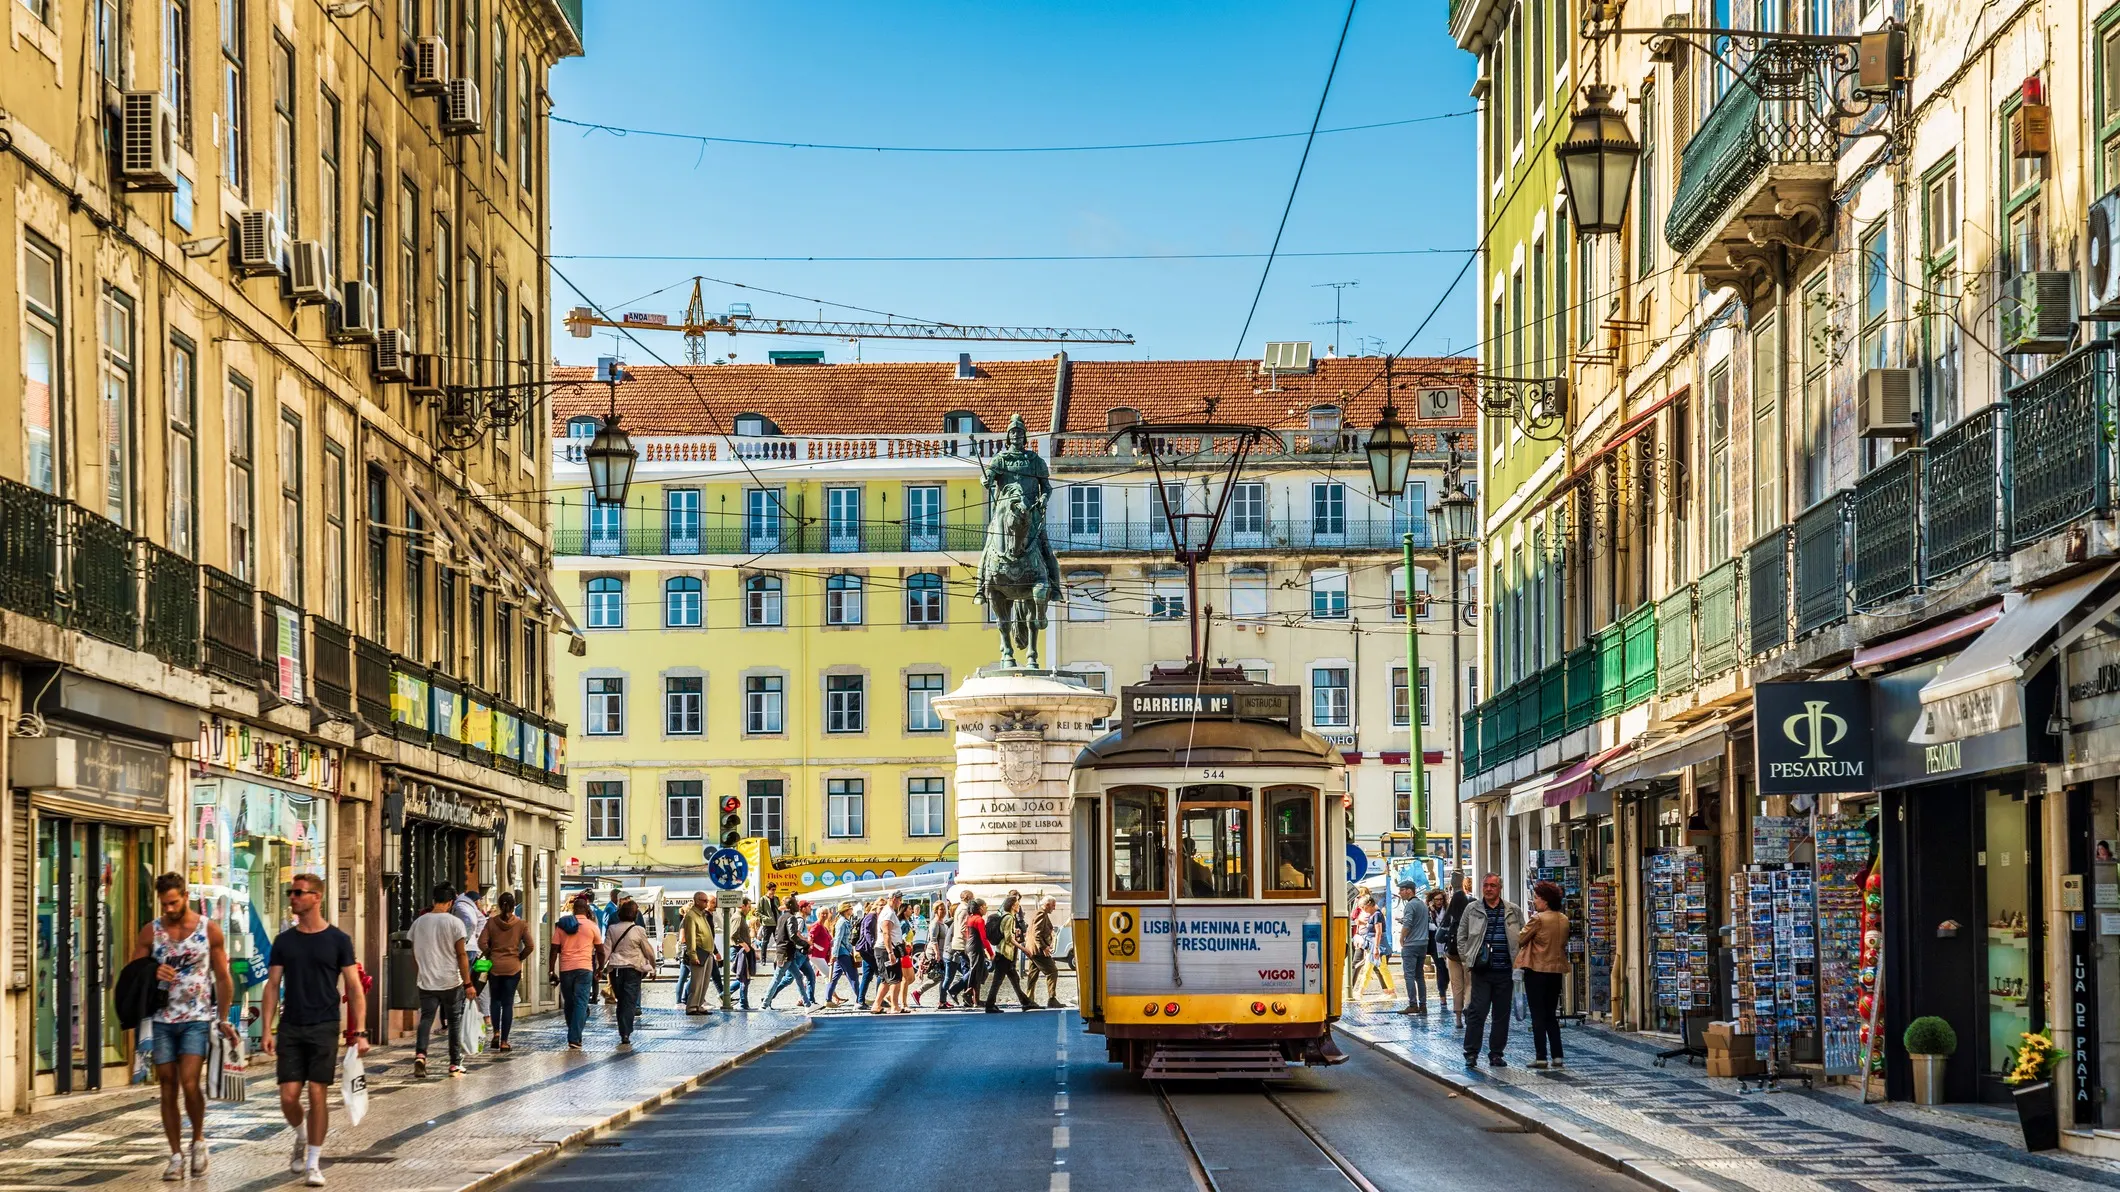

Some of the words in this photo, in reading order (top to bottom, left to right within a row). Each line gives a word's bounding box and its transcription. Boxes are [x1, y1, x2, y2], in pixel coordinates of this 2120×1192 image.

[1428, 391, 1448, 409] 10
[1133, 697, 1203, 712] CARREIRA
[1210, 697, 1228, 712] Nº
[1057, 721, 1070, 730] REI
[1074, 721, 1082, 730] DE
[1925, 741, 1962, 774] PESARUM
[1203, 769, 1225, 779] 544
[1769, 760, 1864, 778] PESARUM
[980, 803, 986, 813] A
[991, 802, 1016, 813] DOM
[980, 821, 986, 829] A
[988, 821, 1017, 829] CIDADE
[1021, 820, 1031, 828] DE
[1035, 820, 1063, 828] LISBOA
[1143, 920, 1188, 934] LISBOA
[1191, 920, 1240, 935] MENINA
[1244, 920, 1251, 934] E
[1253, 920, 1291, 938] MOÇA,
[1175, 937, 1261, 952] FRESQUINHA.
[1258, 969, 1296, 980] VIGOR
[2076, 955, 2086, 992] LUA
[2076, 1003, 2086, 1027] DE
[2076, 1037, 2088, 1101] PRATA
